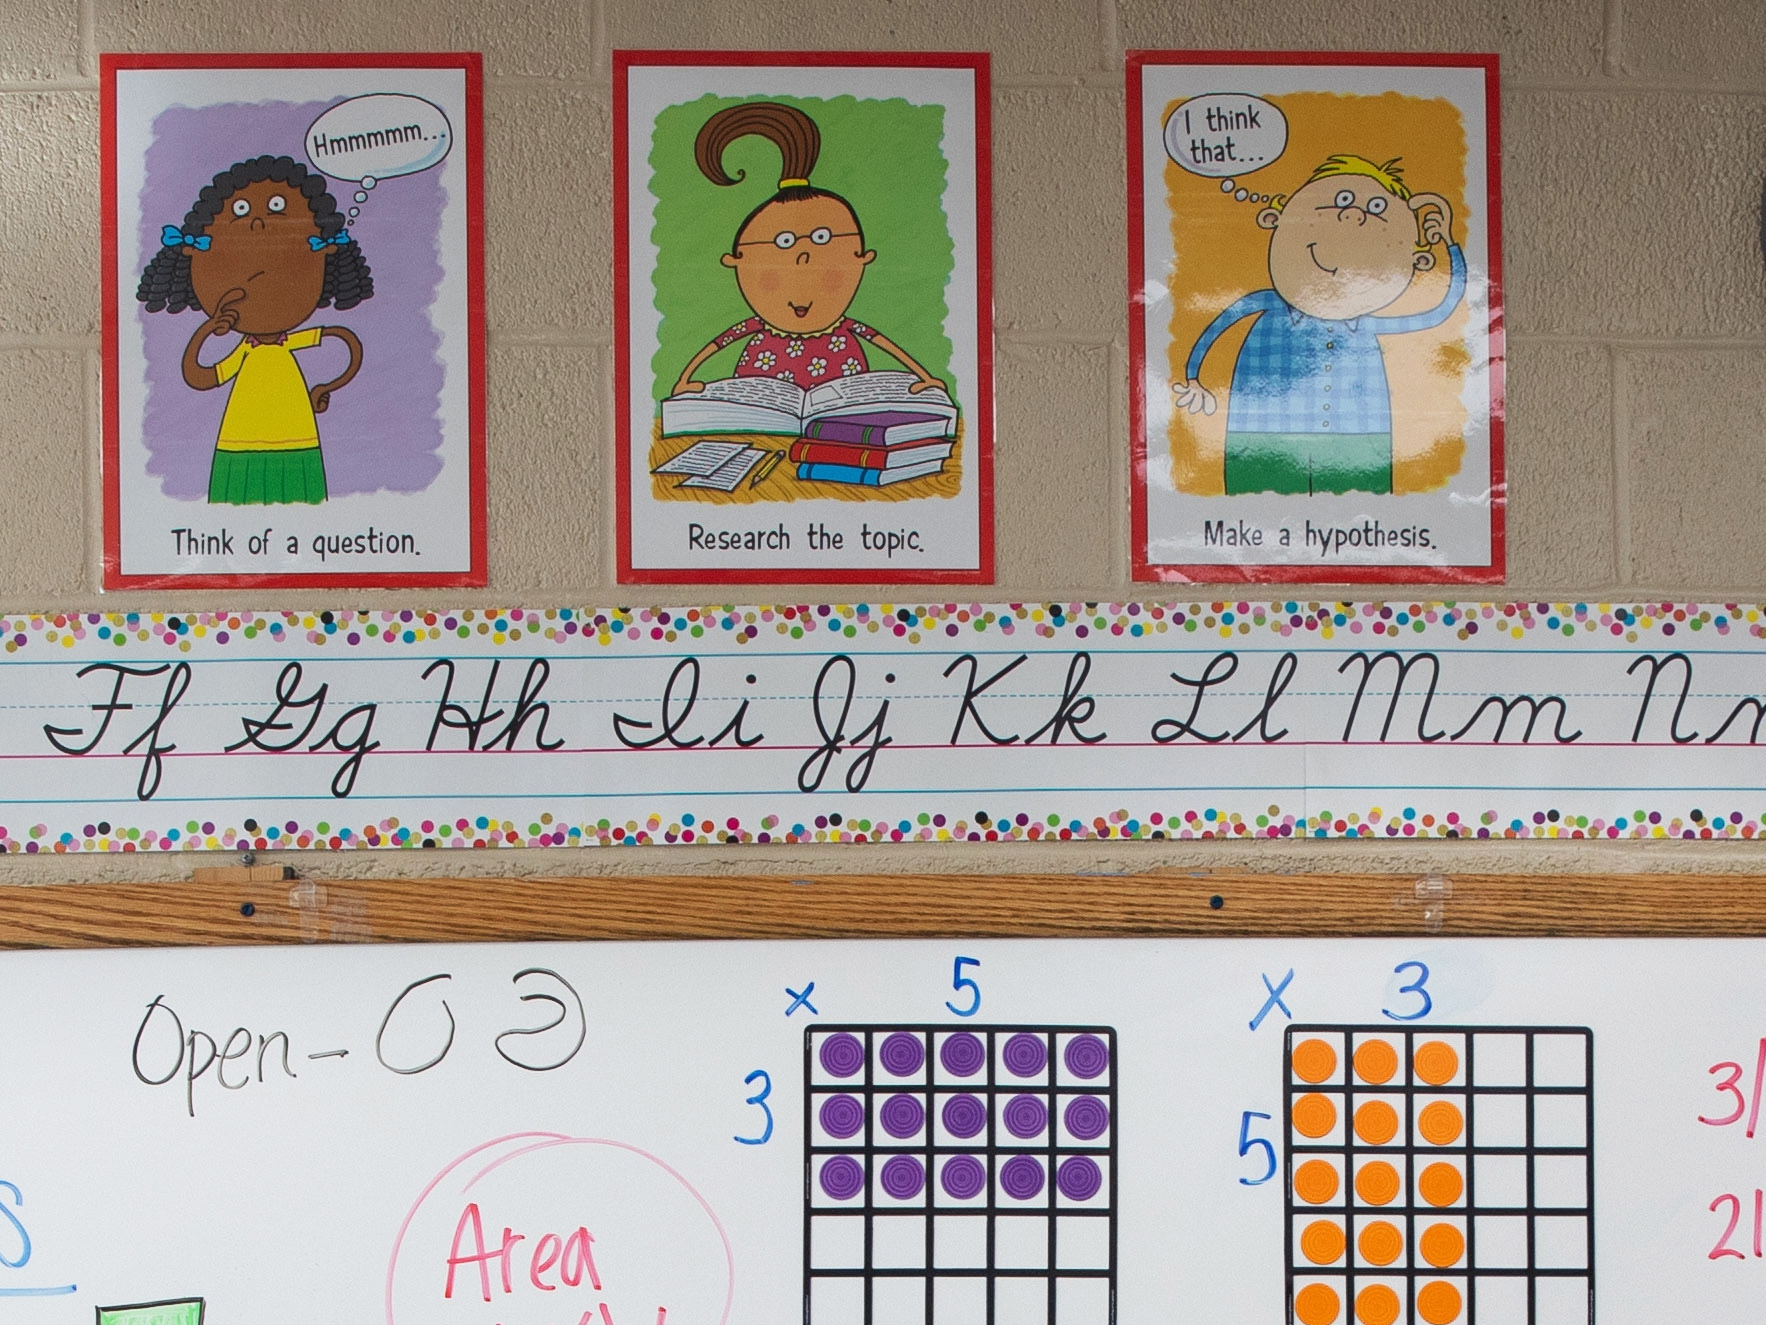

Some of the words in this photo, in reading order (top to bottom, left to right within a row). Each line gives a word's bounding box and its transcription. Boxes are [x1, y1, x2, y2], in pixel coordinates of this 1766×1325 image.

[1183, 110, 1196, 134] I
[1206, 106, 1262, 133] think
[1190, 136, 1267, 168] that...
[171, 528, 235, 556] Think
[249, 527, 271, 556] of
[285, 534, 300, 555] a
[312, 530, 421, 561] question.
[688, 522, 791, 552] Research
[806, 522, 845, 551] the
[860, 525, 924, 557] topic.
[1204, 521, 1265, 549] Make
[1280, 527, 1292, 549] a
[1304, 521, 1436, 556] hypothesis.
[943, 652, 1108, 745] Kk
[1338, 650, 1584, 744] Mm
[945, 955, 983, 1018] 5
[1380, 960, 1435, 1023] 3
[733, 1069, 775, 1147] 3
[1237, 1111, 1278, 1187] 5
[443, 1200, 604, 1303] Area
